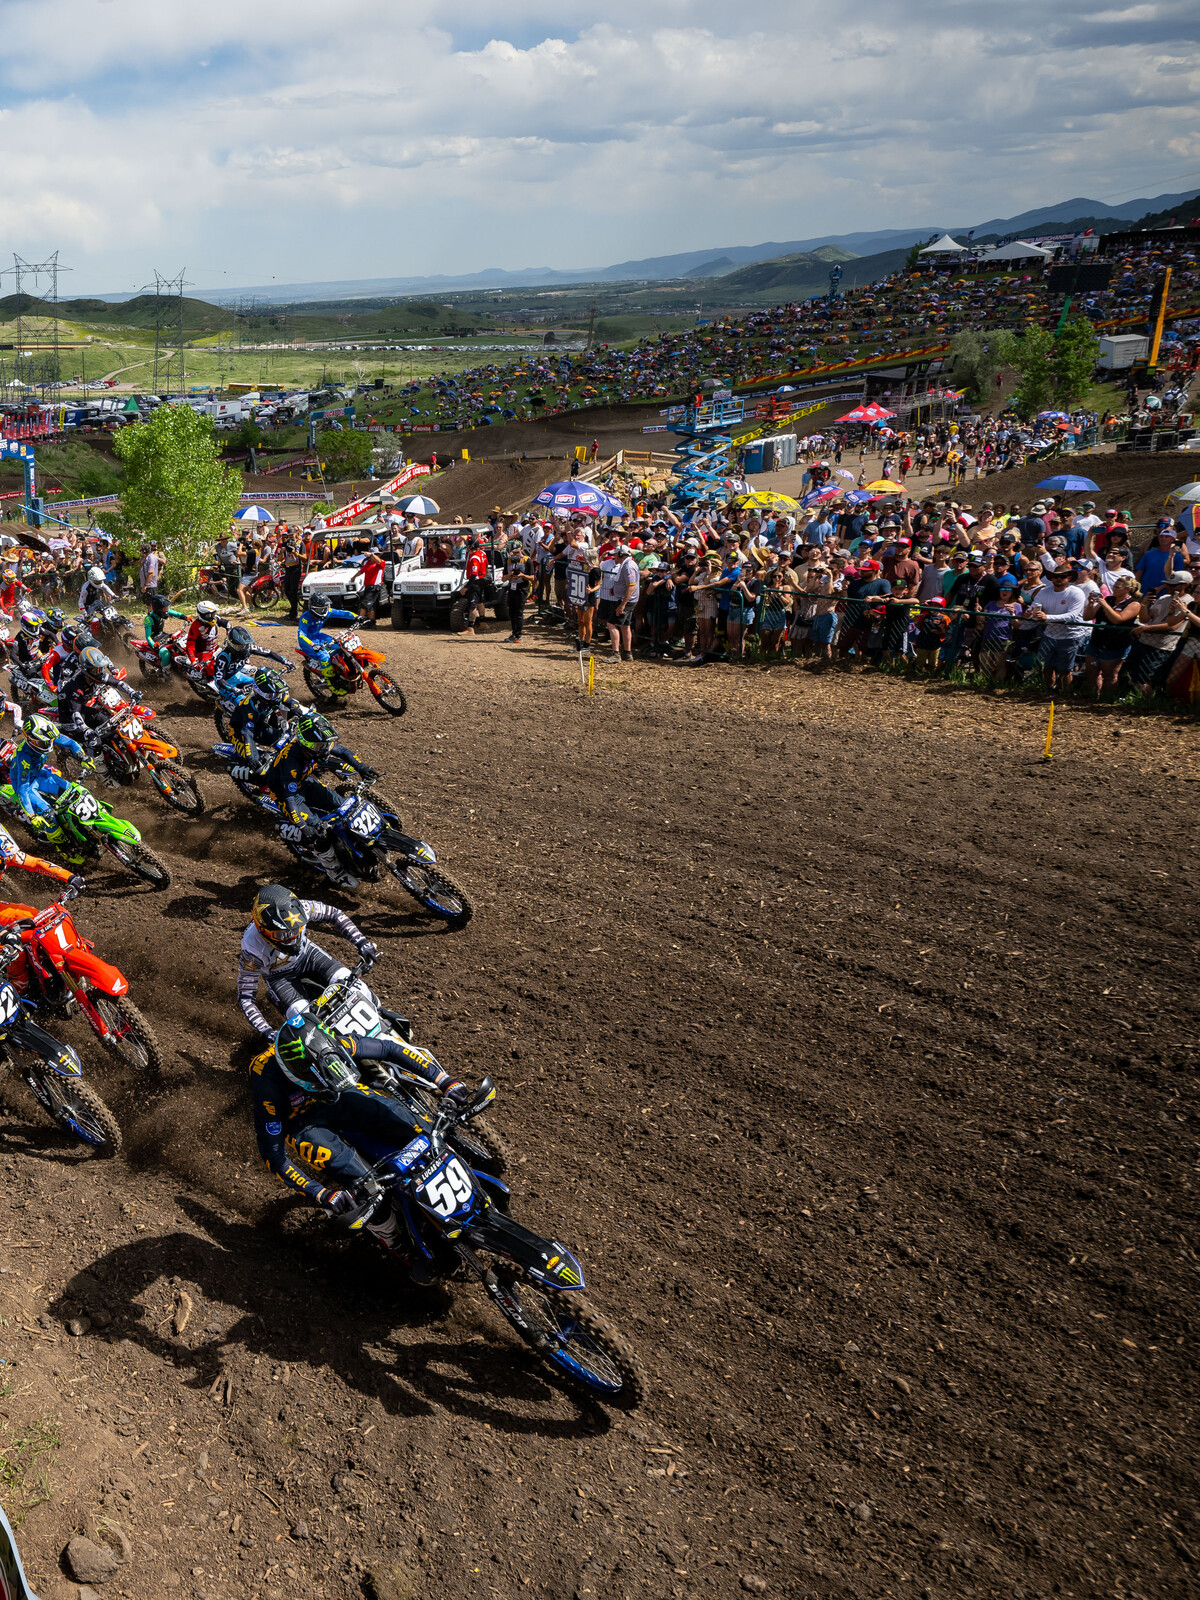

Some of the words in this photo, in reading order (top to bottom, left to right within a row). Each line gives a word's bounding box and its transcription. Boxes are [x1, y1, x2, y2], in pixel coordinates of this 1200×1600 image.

[325, 530, 361, 539] alpinestars
[419, 528, 460, 536] alpinestars
[570, 573, 586, 597] 30
[344, 635, 362, 652] 352
[123, 722, 143, 740] 74
[231, 765, 250, 780] 411
[76, 794, 98, 820] 30
[354, 804, 382, 836] 329
[279, 823, 301, 842] 329
[54, 922, 72, 950] 1
[78, 1002, 100, 1031] DUNLOP
[335, 1000, 376, 1037] 50
[402, 1047, 430, 1069] THOR
[27, 1076, 51, 1106] DUNLOP
[422, 1165, 437, 1181] LUCAS
[425, 1157, 473, 1217] 59
[488, 1283, 529, 1329] DUNLOP
